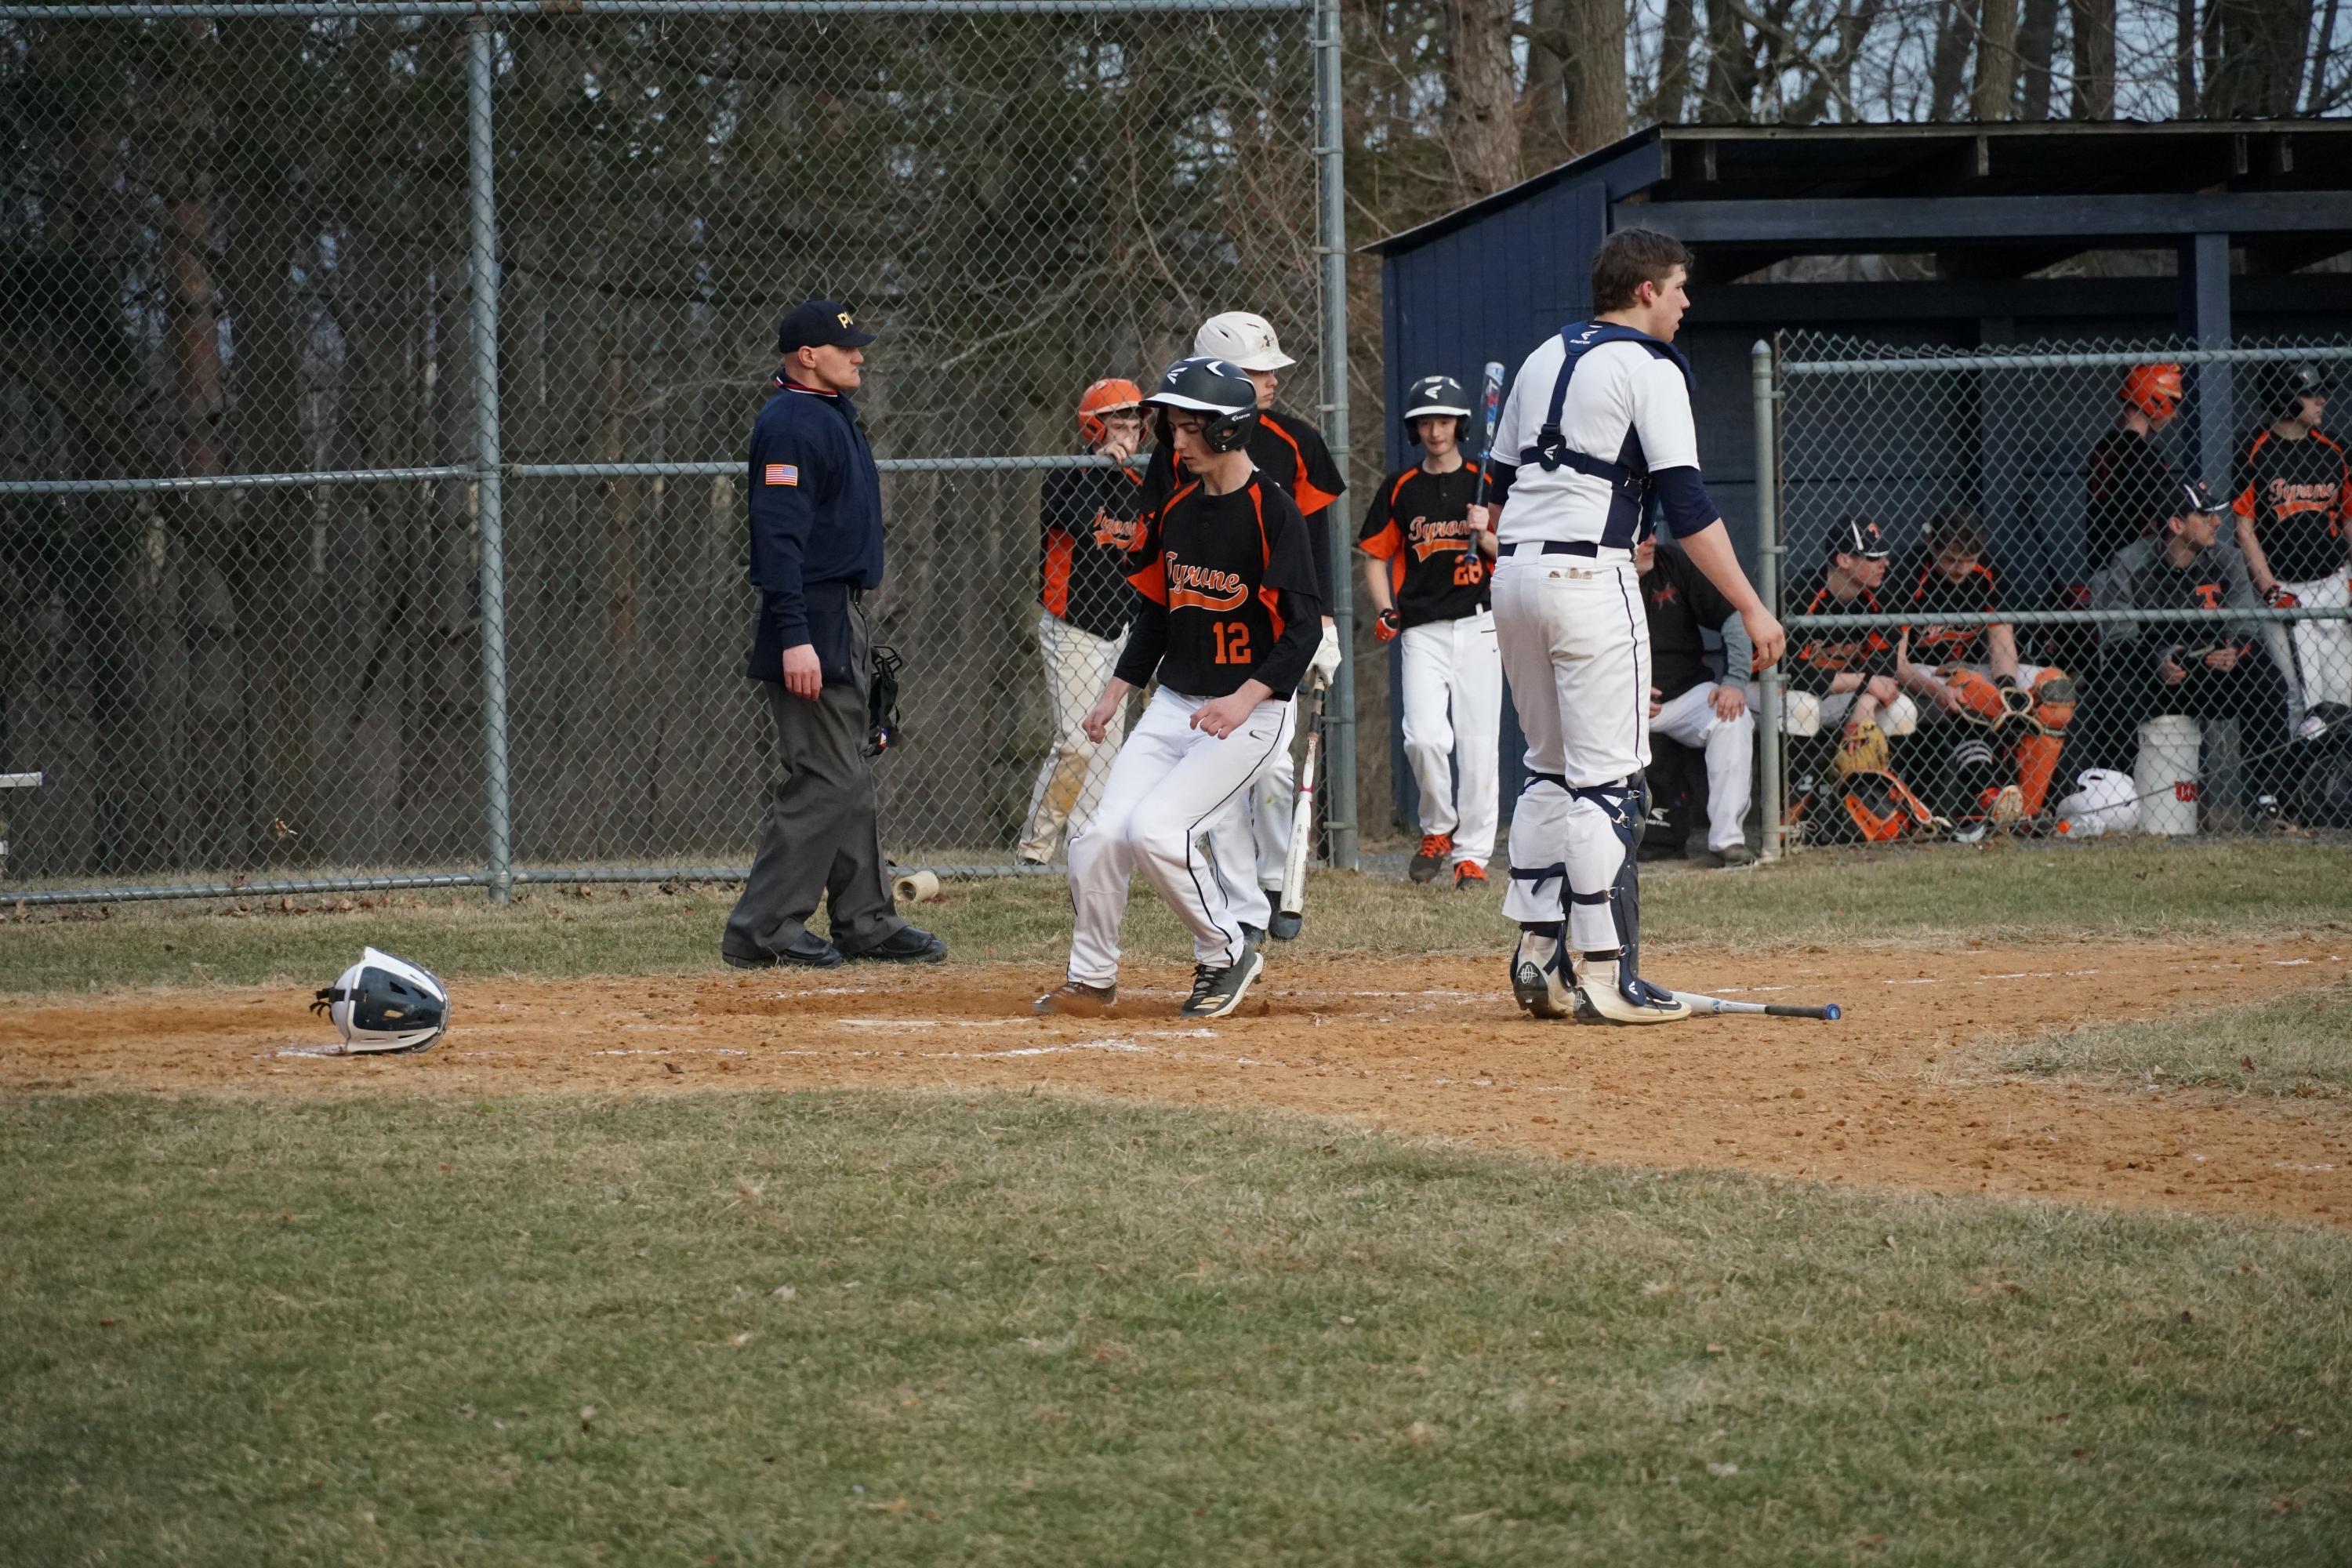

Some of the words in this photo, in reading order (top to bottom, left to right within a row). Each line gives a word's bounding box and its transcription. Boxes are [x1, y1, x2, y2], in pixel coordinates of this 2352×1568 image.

[1408, 516, 1468, 546] Tyron
[1166, 551, 1240, 593] Tyrone
[1213, 622, 1251, 664] 12
